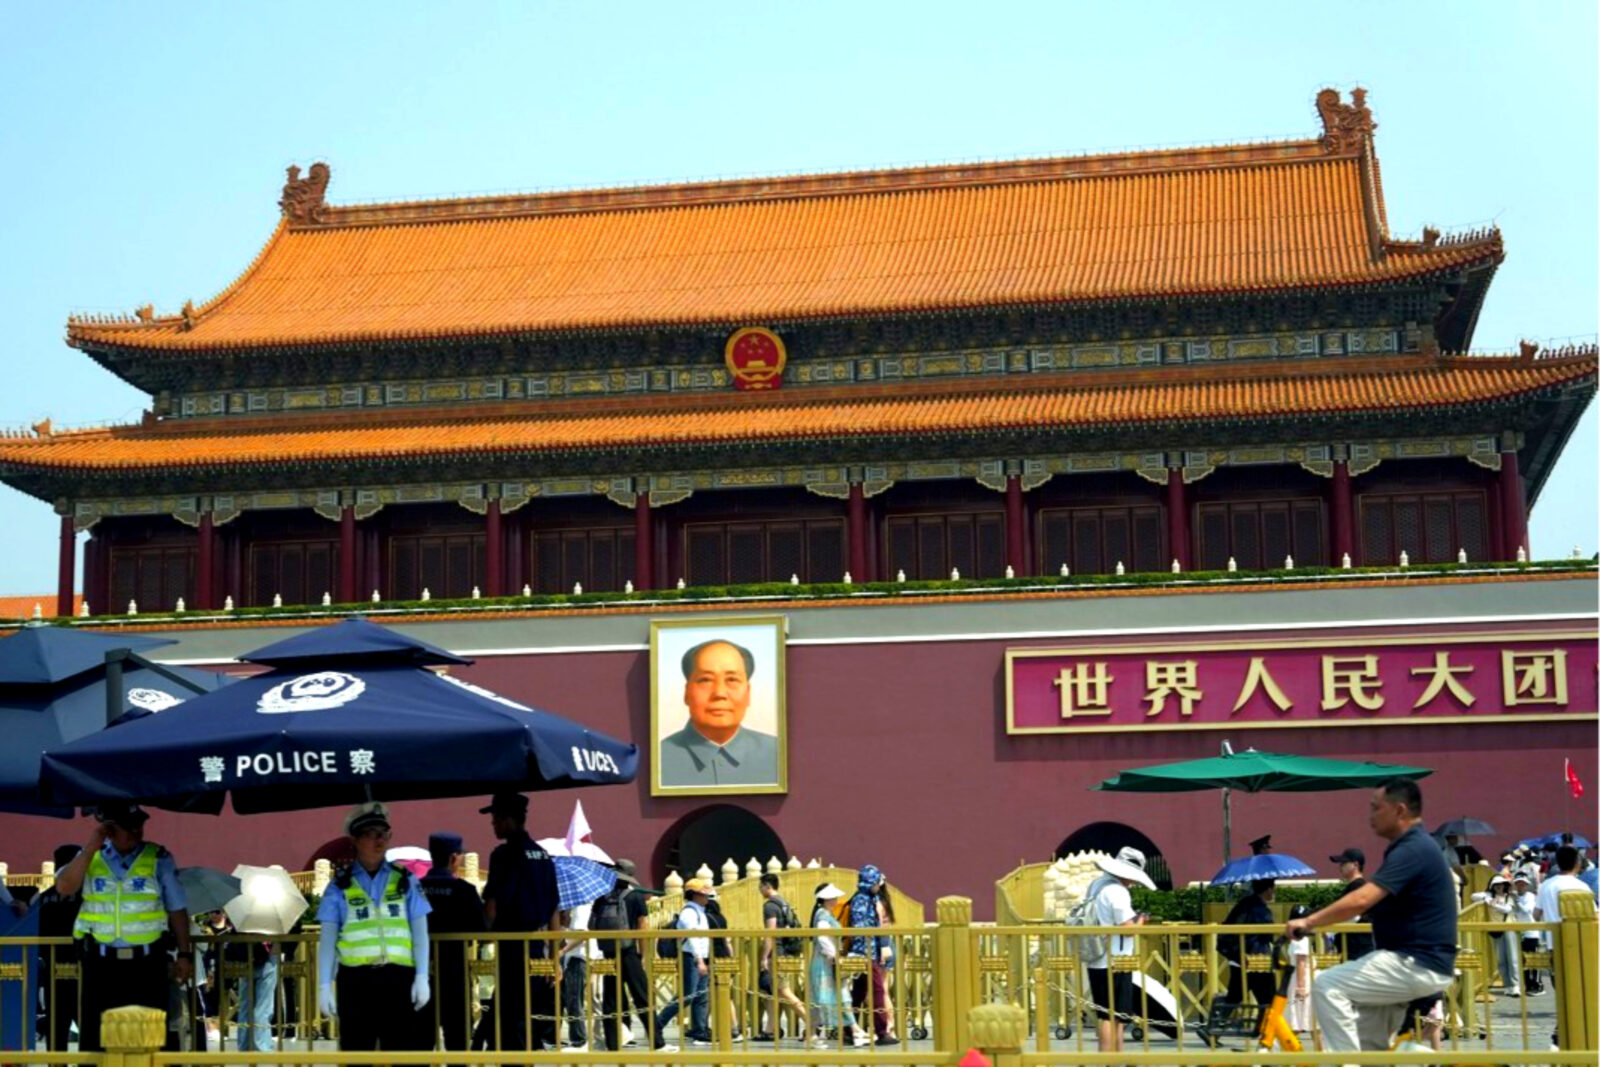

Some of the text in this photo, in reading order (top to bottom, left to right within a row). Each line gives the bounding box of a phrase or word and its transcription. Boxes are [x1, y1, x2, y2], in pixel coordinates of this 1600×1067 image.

[199, 749, 376, 783] 警 POLICE 察
